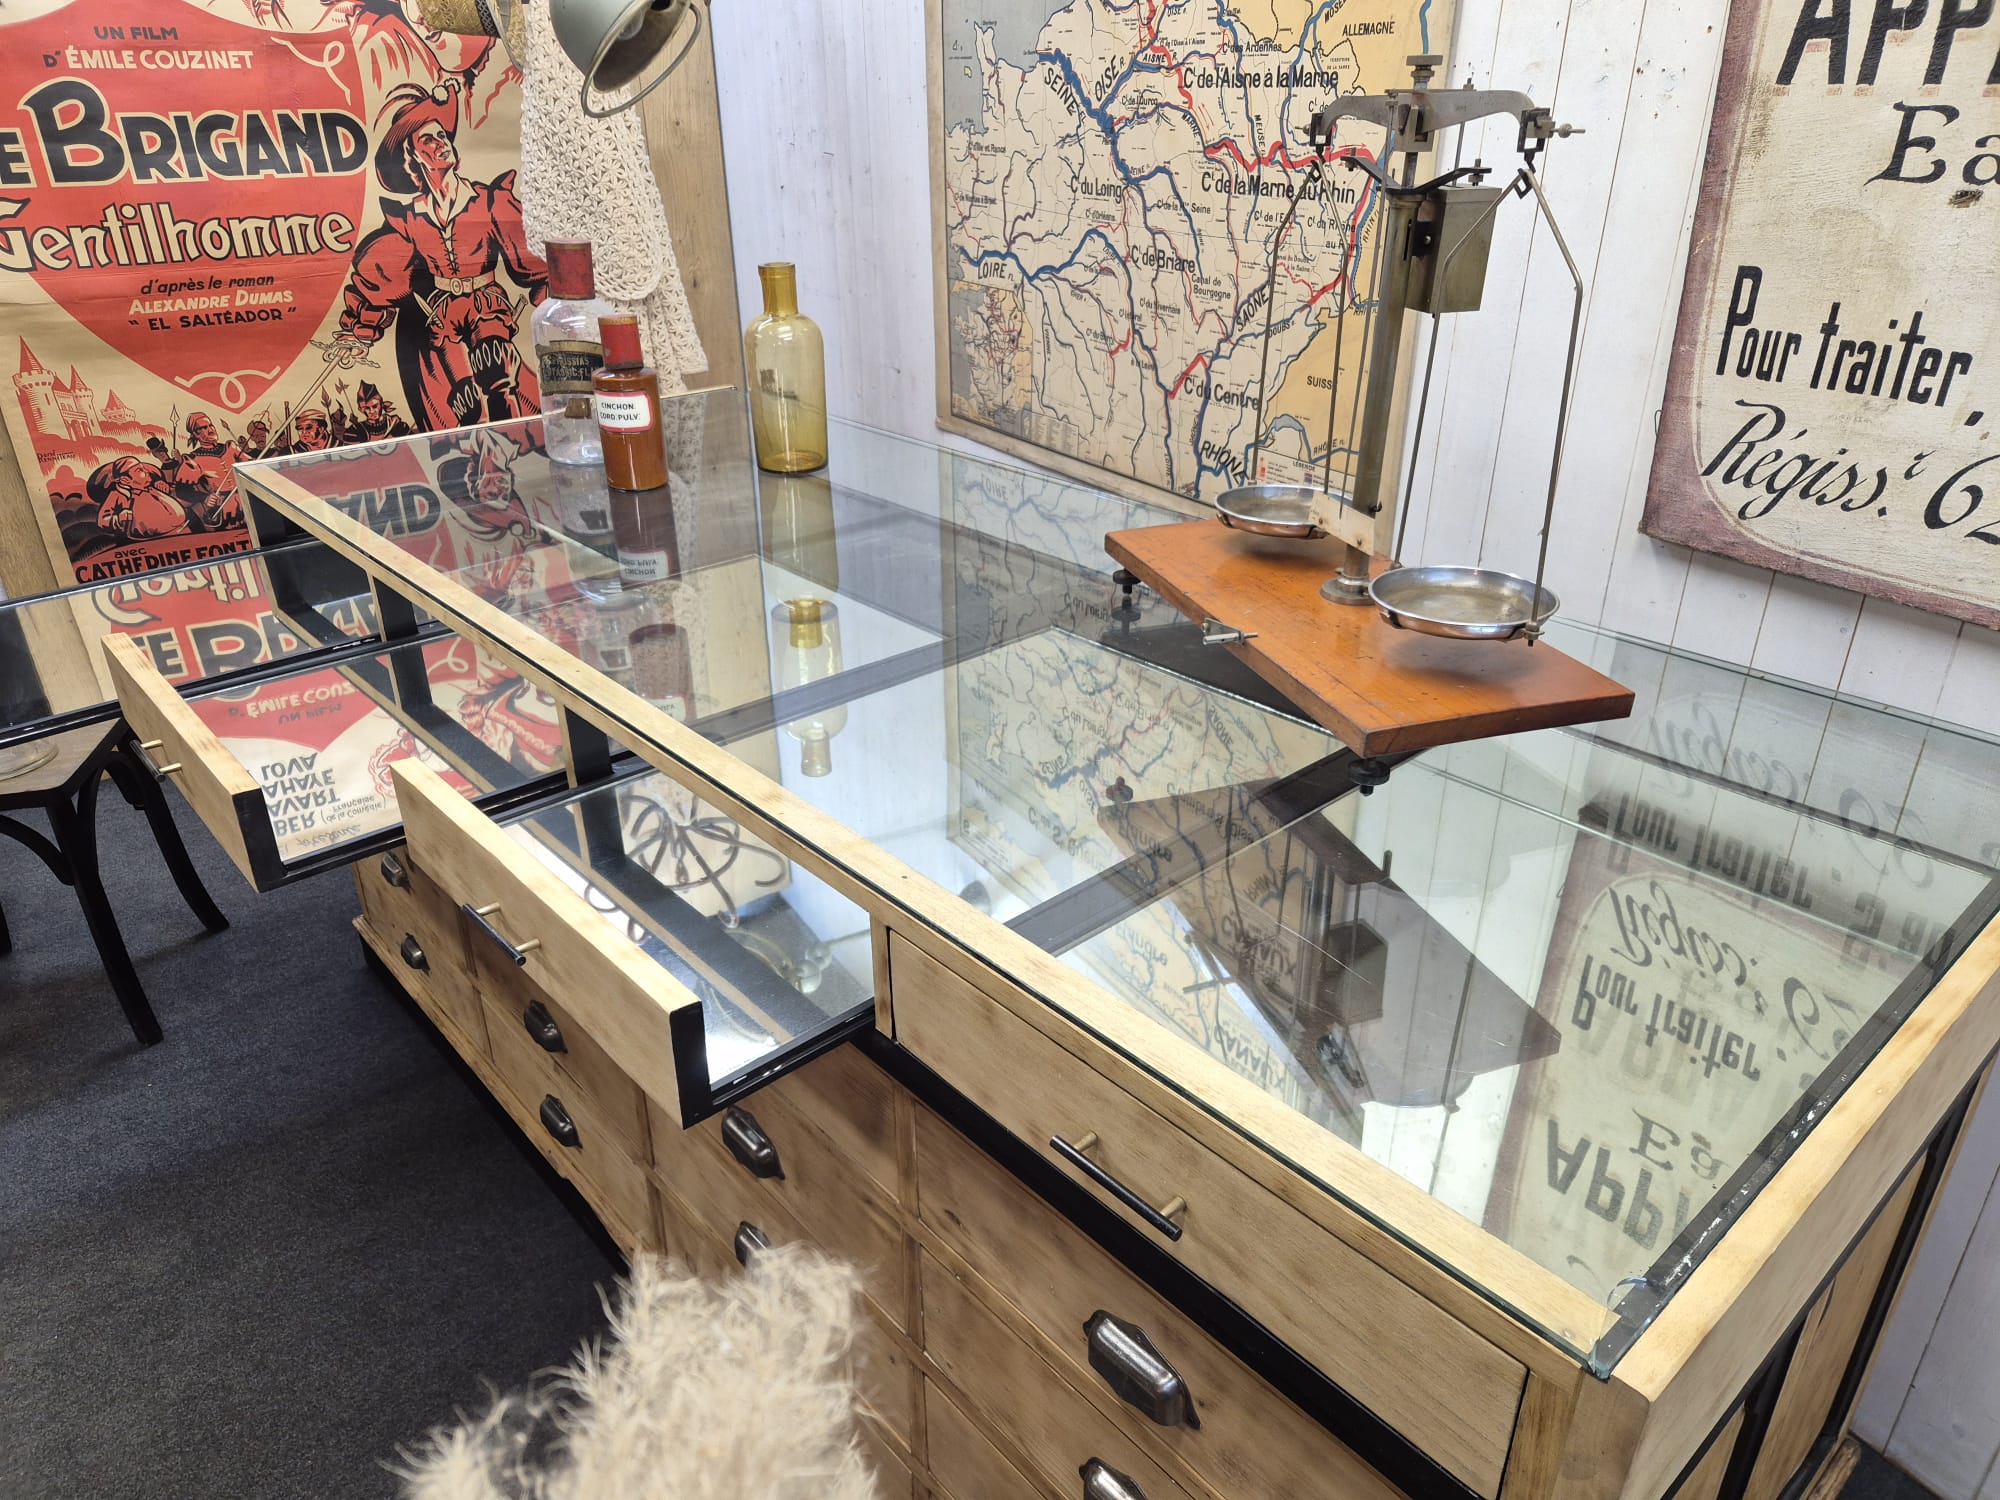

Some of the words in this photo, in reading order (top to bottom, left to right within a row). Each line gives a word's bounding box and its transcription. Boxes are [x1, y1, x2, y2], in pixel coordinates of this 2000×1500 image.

[94, 26, 126, 41] UN
[131, 26, 179, 41] FILM
[1342, 20, 1396, 37] ALLEMAGNE
[1246, 40, 1282, 53] Ardennes
[1775, 0, 2000, 88] APP
[66, 45, 137, 70] ÉMILE
[140, 49, 254, 71] COUZINET
[1095, 55, 1120, 102] OISE
[1197, 66, 1213, 88] de
[1216, 65, 1261, 89] l'Aisne
[1264, 69, 1273, 88] à
[1276, 65, 1289, 88] la
[1293, 64, 1339, 89] Marne
[1045, 67, 1078, 116] SEINE
[17, 76, 370, 188] BRIGAND
[1254, 114, 1264, 148] MEUSE
[0, 127, 38, 189] E
[1081, 178, 1093, 196] du
[1096, 177, 1122, 204] Loing
[1216, 175, 1230, 194] de
[1234, 175, 1246, 194] la
[1249, 175, 1295, 199] Marne
[1191, 203, 1211, 214] Seine
[1264, 212, 1273, 222] de
[0, 197, 356, 273] Gentilhomme
[978, 261, 1007, 280] LOIRE
[1142, 250, 1156, 267] de
[1157, 249, 1196, 273] Briare
[140, 278, 205, 297] d'après
[208, 275, 223, 290] le
[228, 276, 274, 289] roman
[1191, 273, 1211, 286] Canal
[1212, 275, 1222, 287] de
[129, 294, 231, 316] ALEXANDRE
[235, 289, 293, 307] DUMAS
[1193, 285, 1231, 301] Bourgogne
[1716, 266, 1801, 381] Pour
[1196, 379, 1211, 401] du
[1214, 383, 1261, 411] Centre
[1307, 375, 1333, 390] SUISS
[114, 547, 148, 560] avec
[195, 539, 254, 564] FONT
